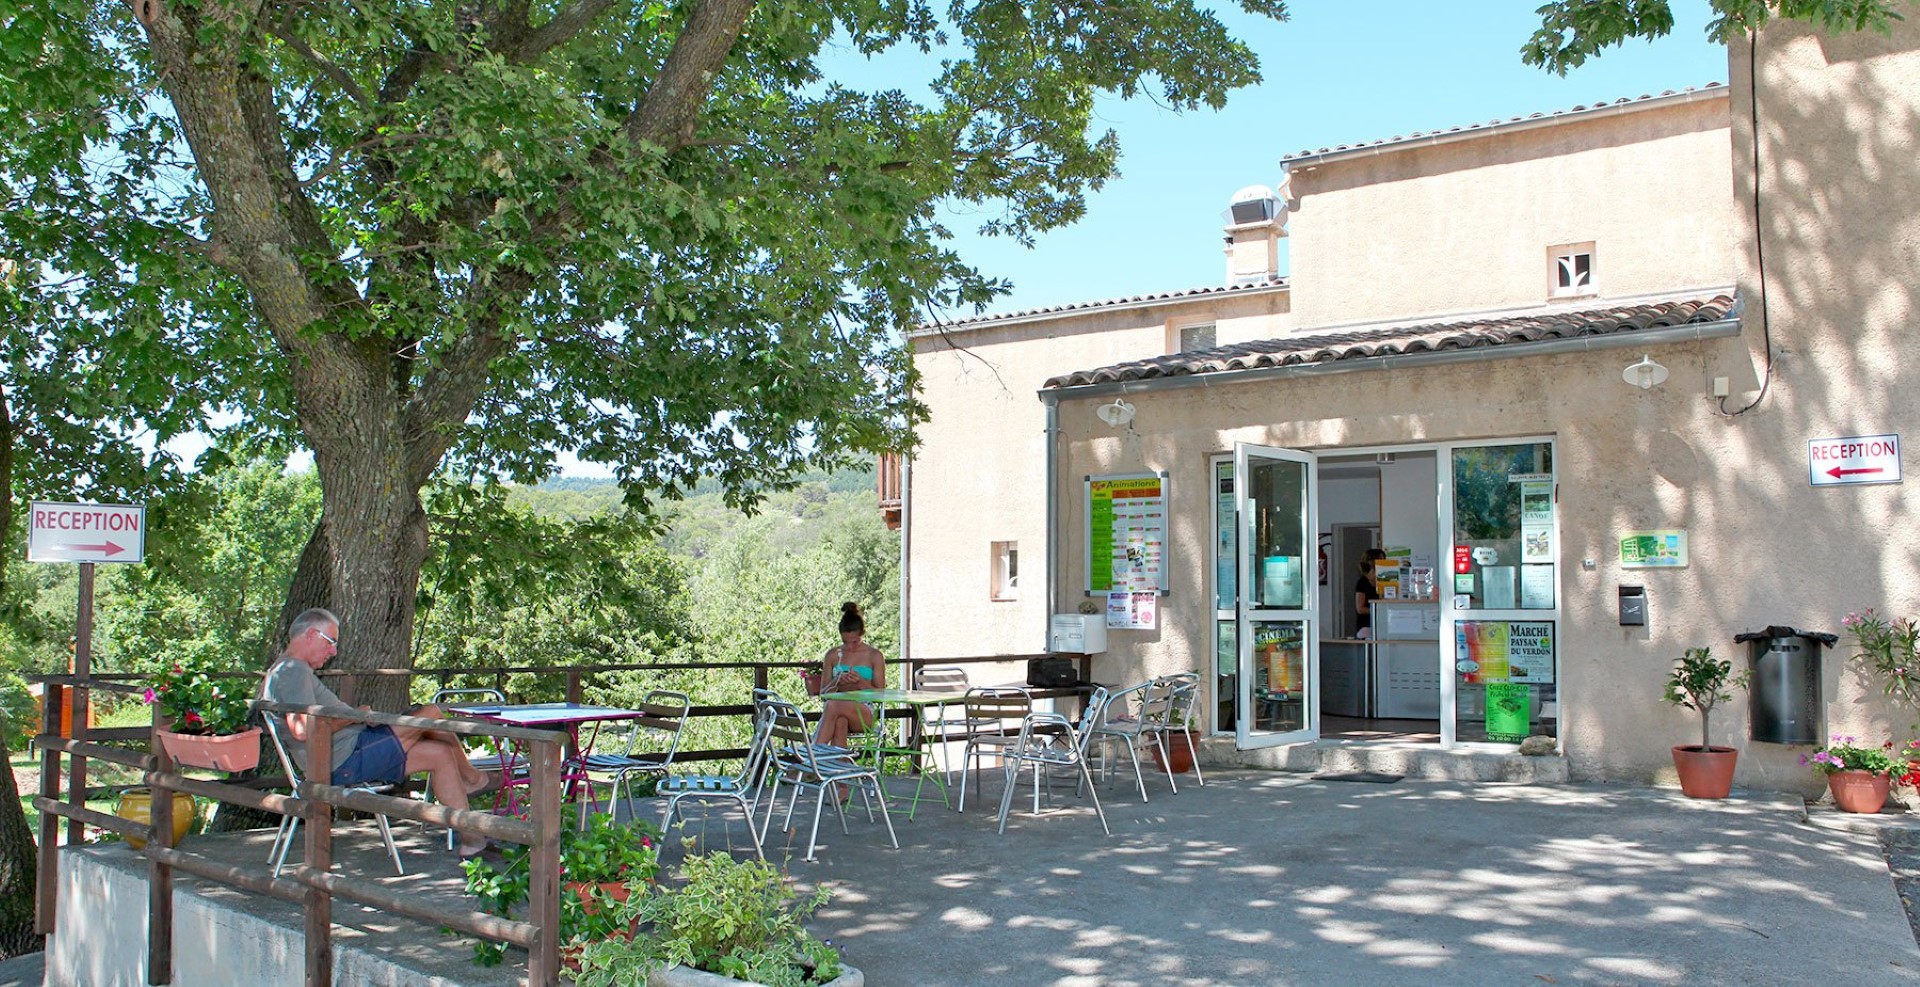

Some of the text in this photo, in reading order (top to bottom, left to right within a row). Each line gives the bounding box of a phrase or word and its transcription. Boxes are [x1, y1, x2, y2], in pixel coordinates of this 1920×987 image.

[1812, 441, 1895, 460] RECEPTION
[35, 511, 139, 531] RECEPTION
[1510, 625, 1549, 637] MARCHÉ
[1510, 638, 1538, 647] PAYSAN
